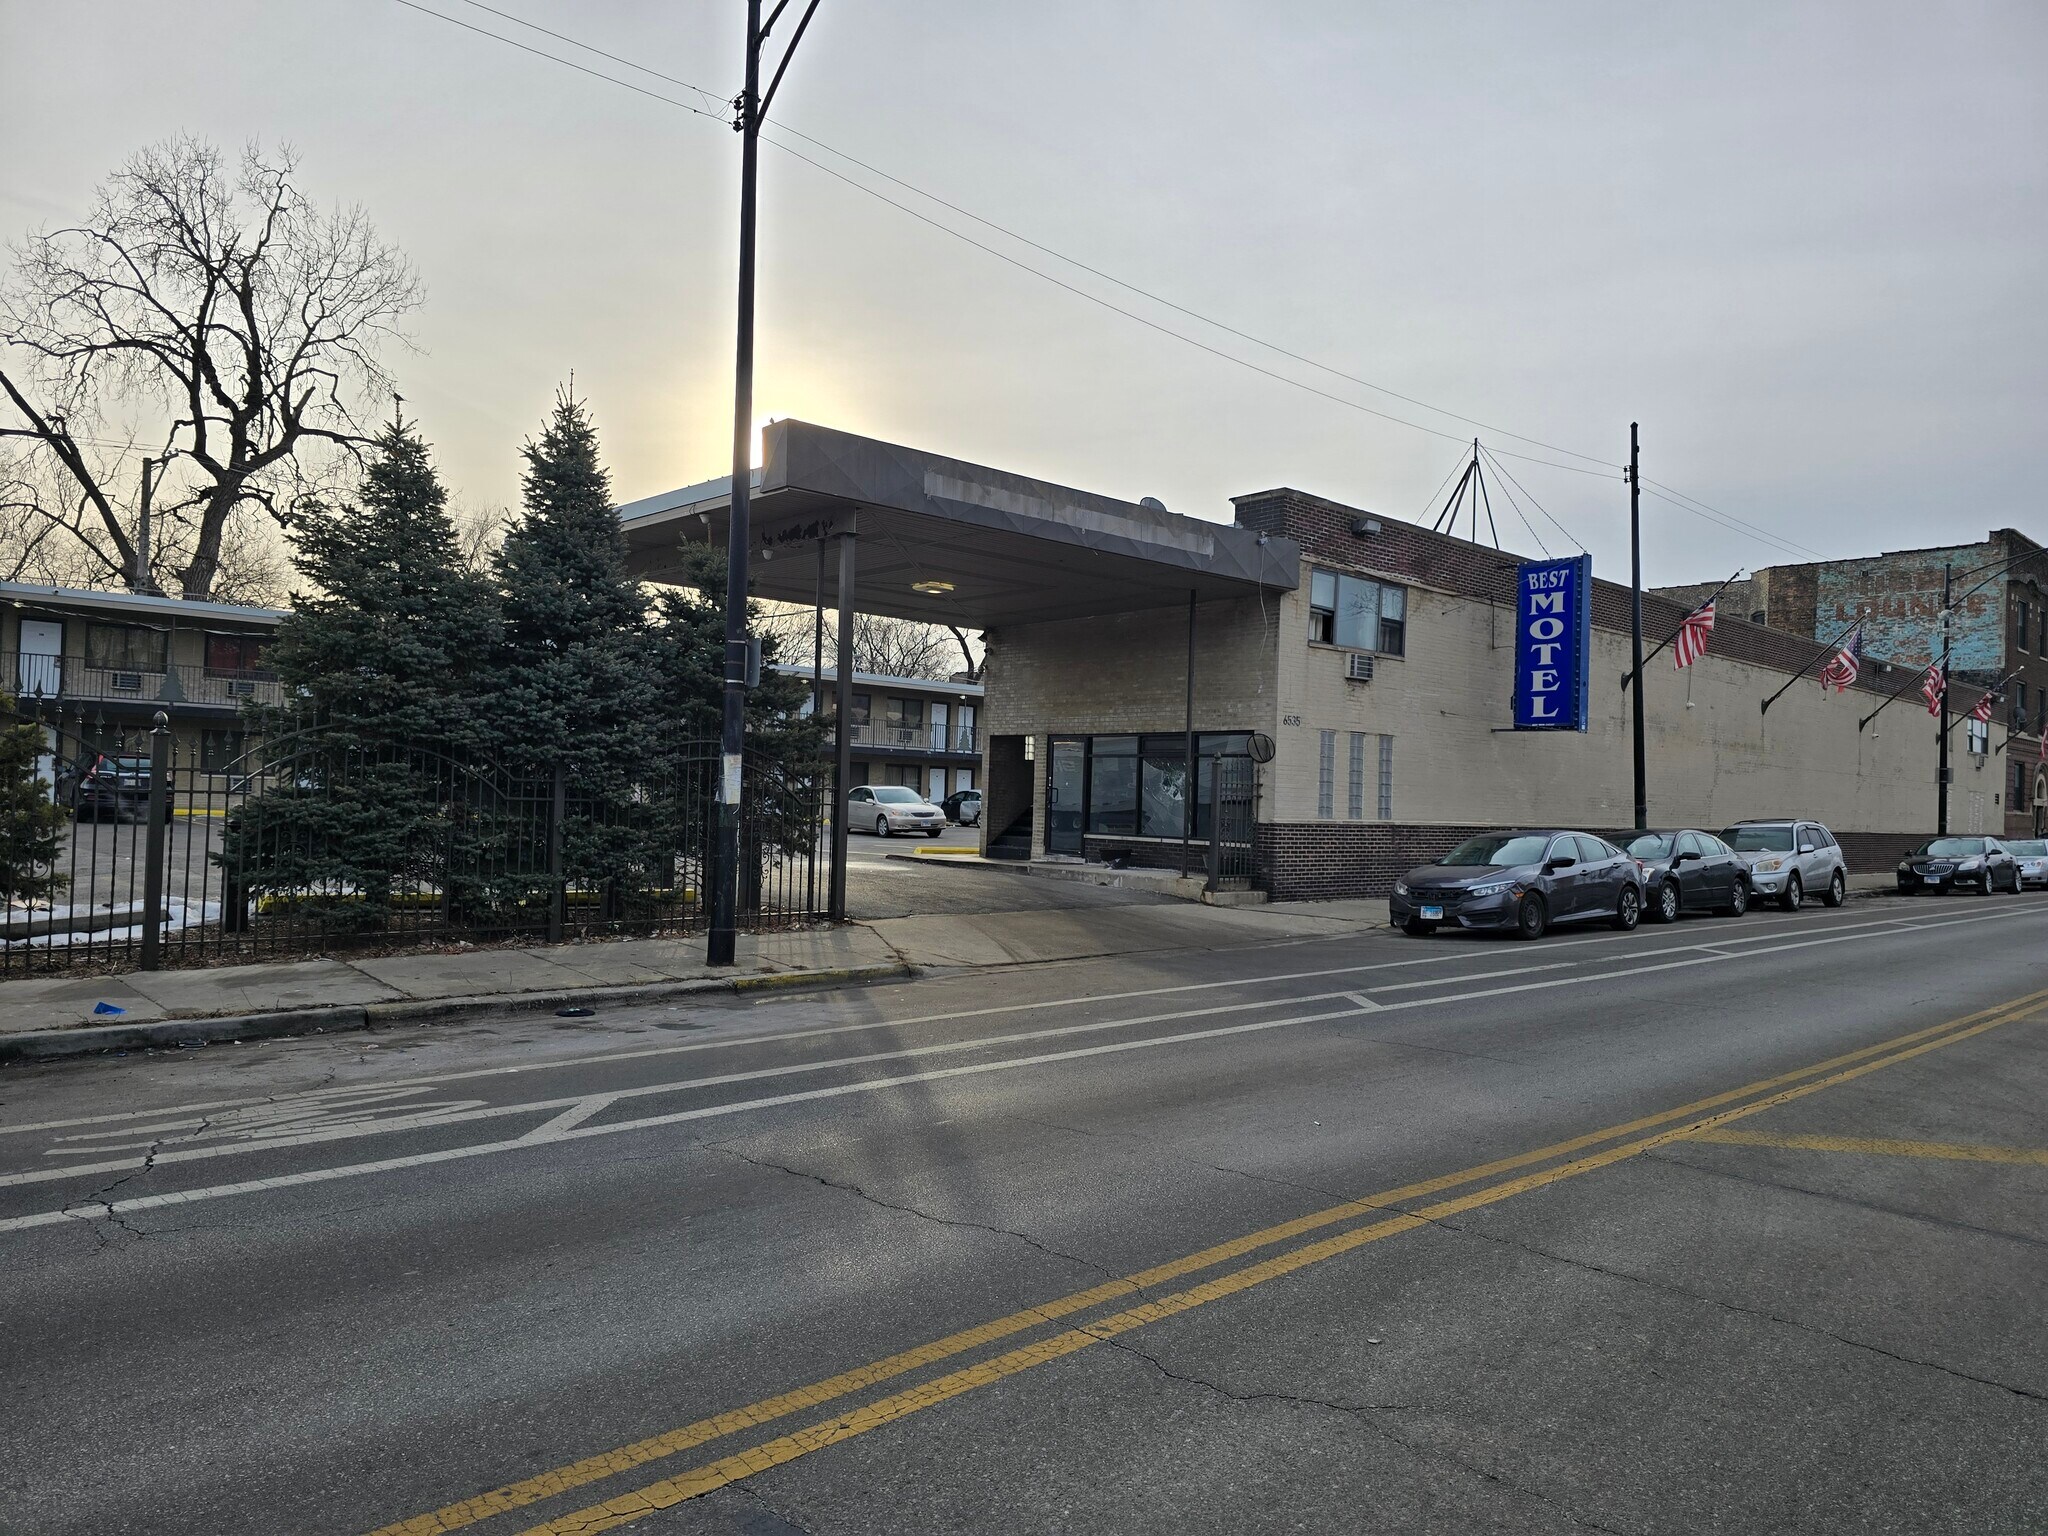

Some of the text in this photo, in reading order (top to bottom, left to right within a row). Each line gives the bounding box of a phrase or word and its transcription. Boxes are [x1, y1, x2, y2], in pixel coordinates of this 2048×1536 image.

[1528, 569, 1570, 590] BEST
[1529, 591, 1566, 718] MOTEL
[1283, 715, 1301, 727] 6535
